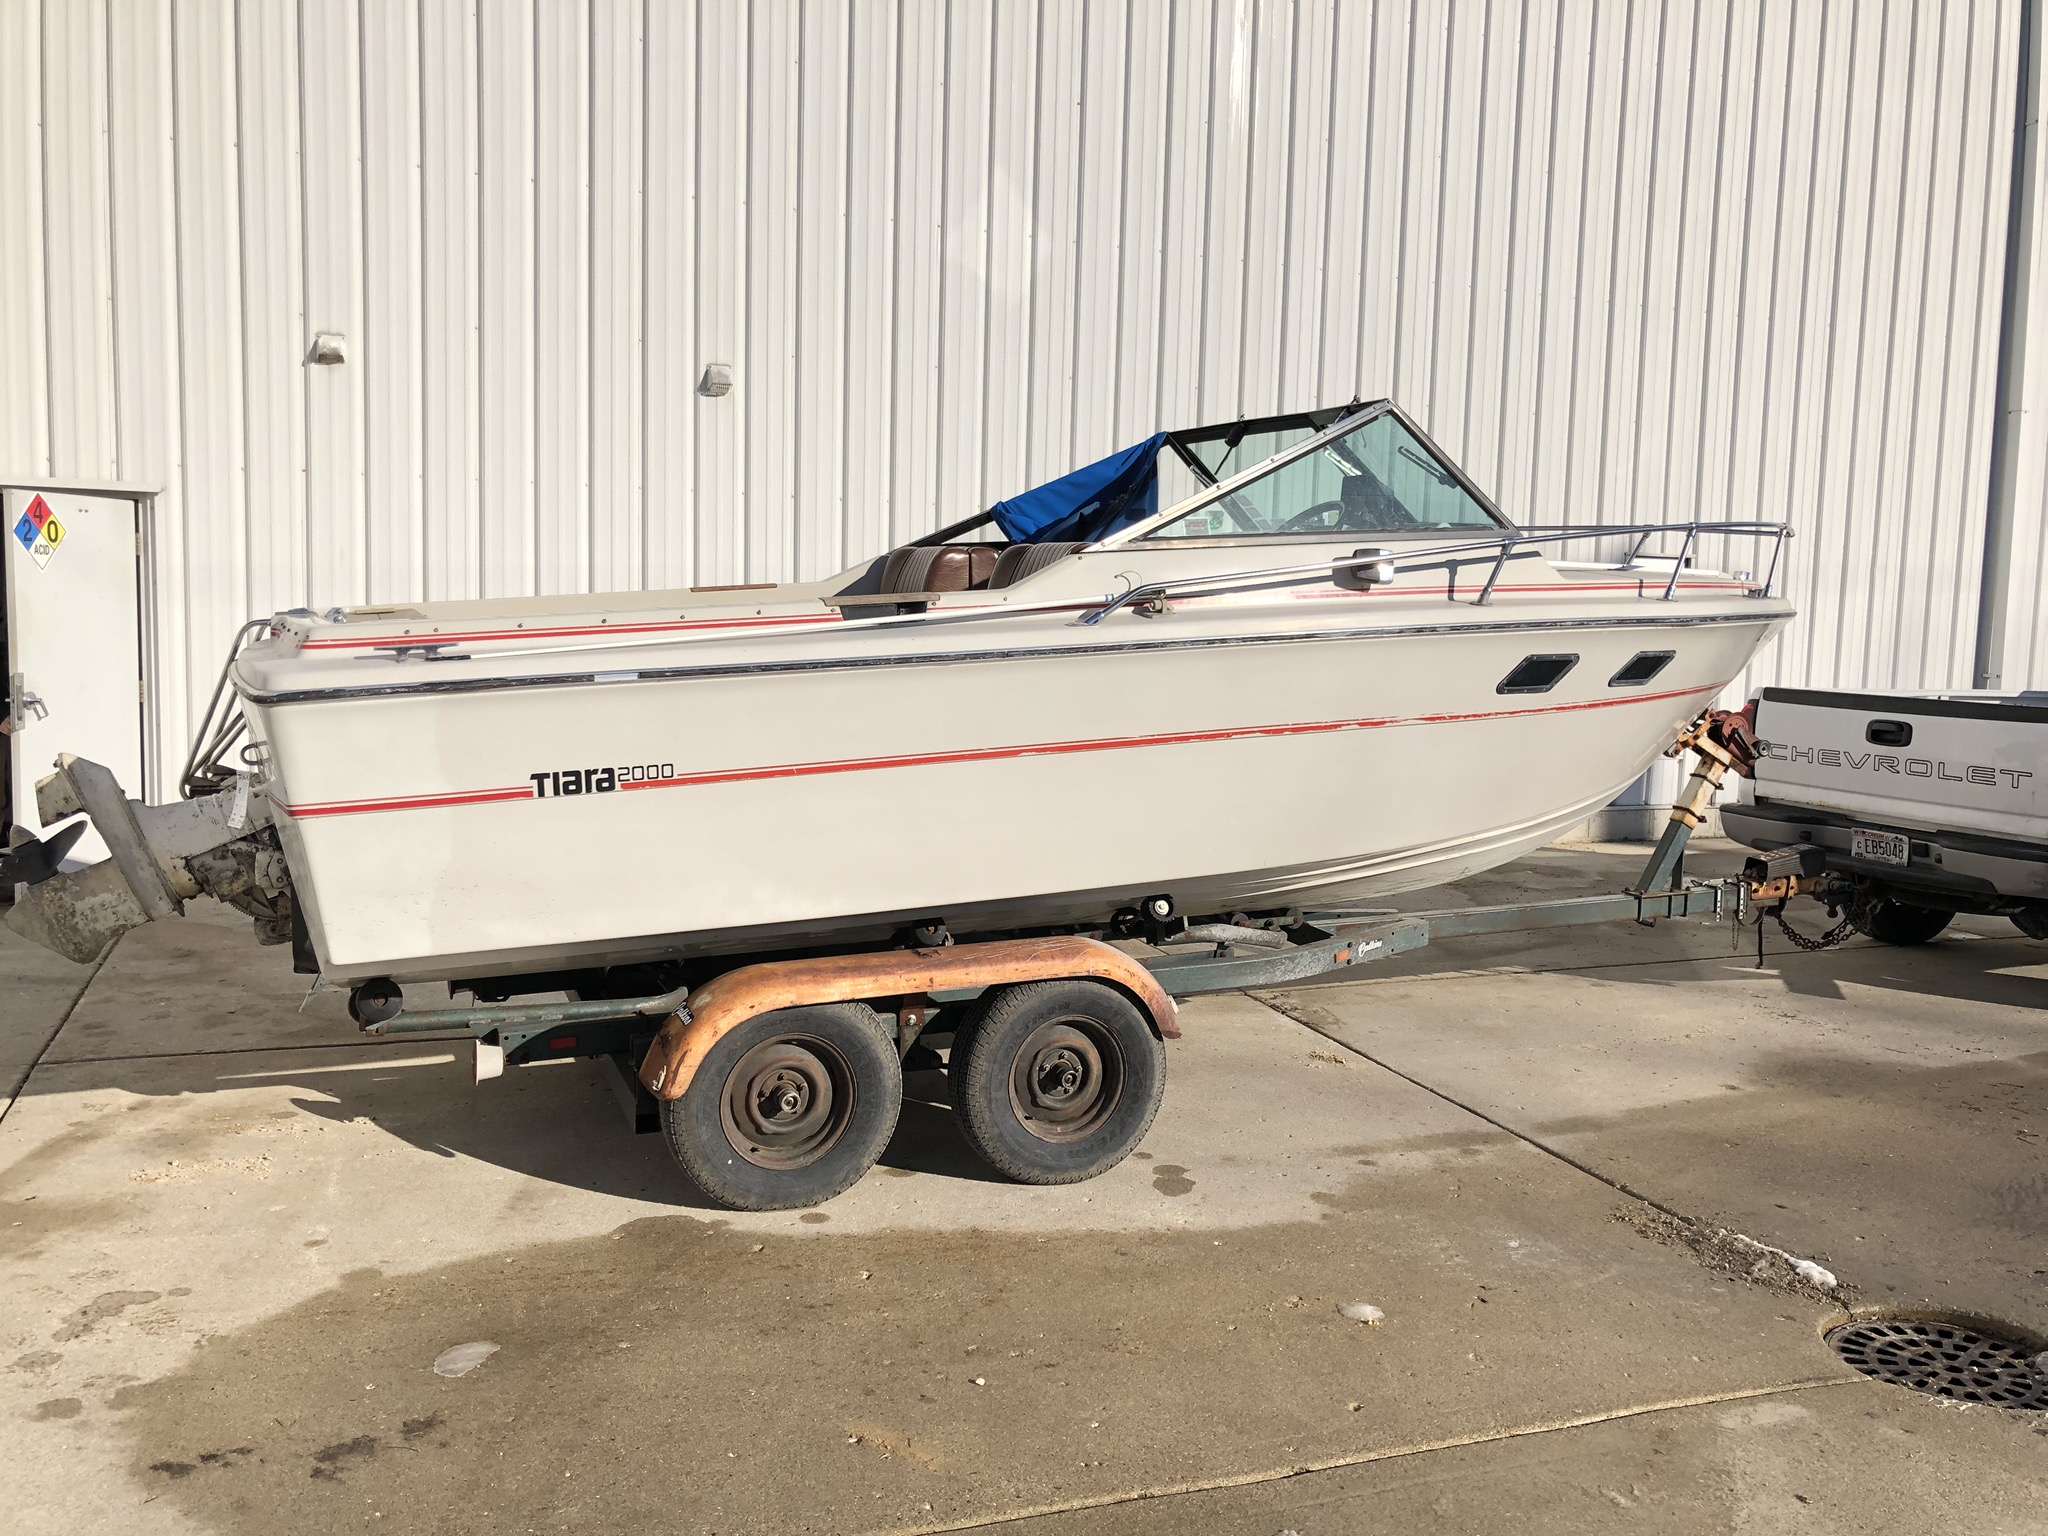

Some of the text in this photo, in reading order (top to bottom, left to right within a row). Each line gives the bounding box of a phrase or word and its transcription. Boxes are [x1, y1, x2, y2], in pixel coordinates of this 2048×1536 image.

[33, 501, 44, 523] 4
[22, 518, 58, 543] 2 0
[34, 544, 50, 555] ACID
[618, 763, 674, 782] 2000
[1769, 743, 2033, 789] CHEVROLET
